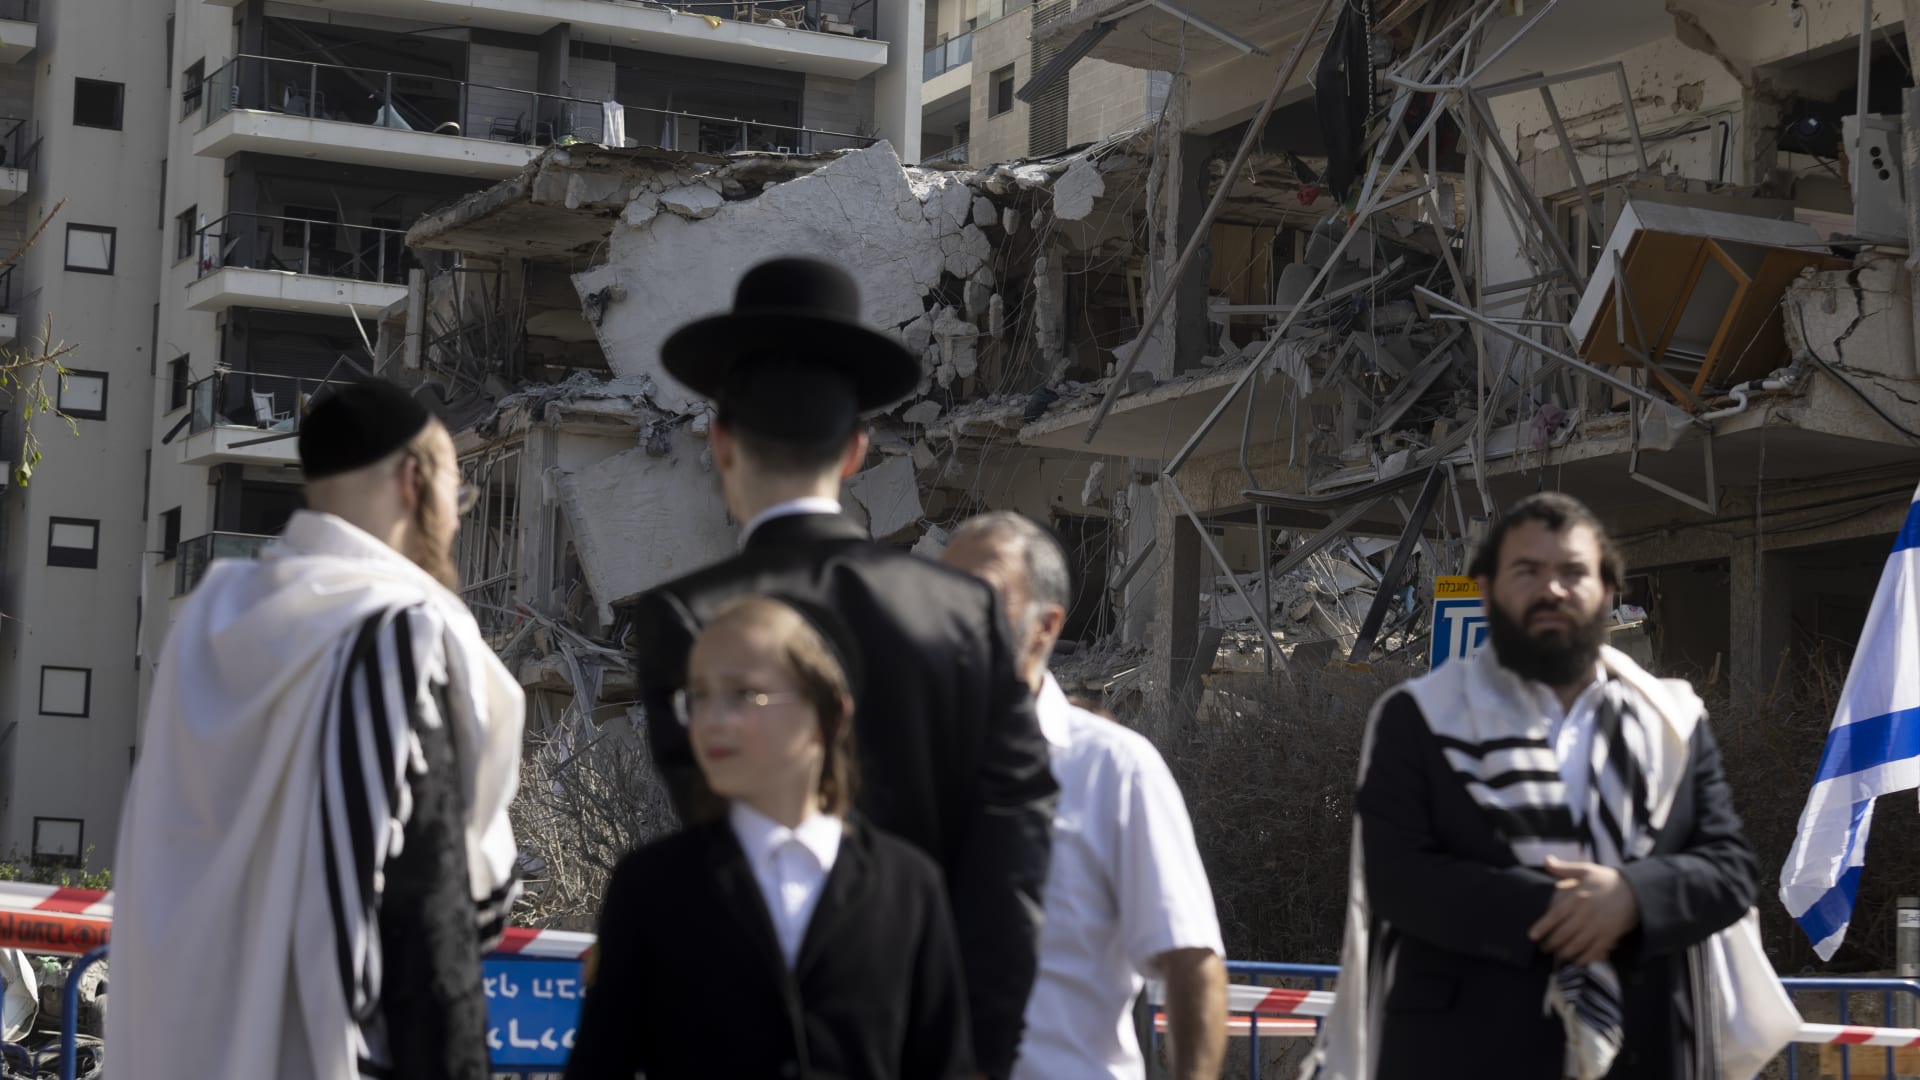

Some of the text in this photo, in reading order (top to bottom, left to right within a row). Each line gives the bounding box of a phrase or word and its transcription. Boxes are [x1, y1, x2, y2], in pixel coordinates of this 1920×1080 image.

[1438, 581, 1470, 593] מוגבלת
[483, 973, 519, 998] גף
[486, 1018, 576, 1050] יריי
